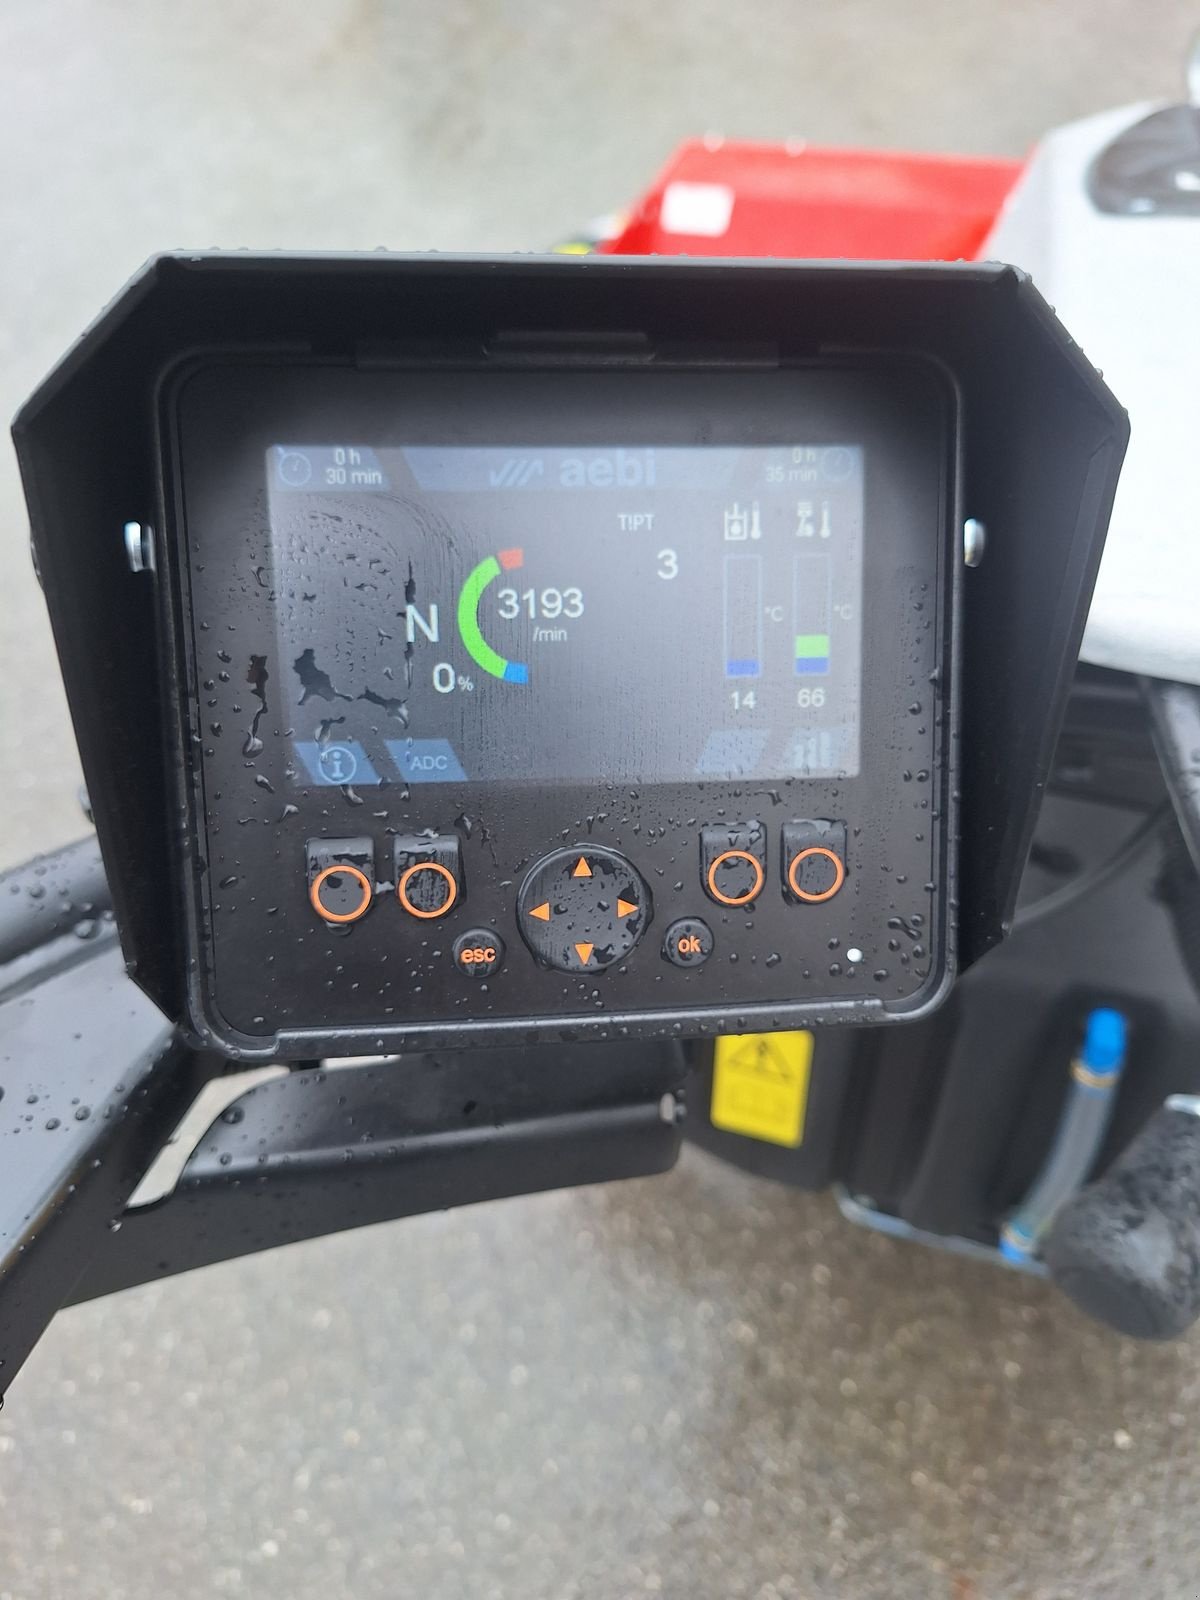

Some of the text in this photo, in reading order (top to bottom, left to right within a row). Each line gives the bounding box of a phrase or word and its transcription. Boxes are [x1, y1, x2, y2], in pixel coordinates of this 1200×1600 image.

[335, 449, 361, 465] 0 h
[326, 468, 382, 485] 30 min
[559, 448, 656, 487] aebi
[788, 468, 817, 482] min
[617, 513, 655, 531] TIPT
[656, 548, 679, 580] 3
[497, 587, 585, 619] 3193
[405, 603, 439, 643] N
[532, 626, 567, 643] /min
[730, 691, 757, 710] 14
[797, 688, 825, 708] 66
[410, 755, 448, 771] ADC
[677, 935, 701, 953] ok
[460, 947, 497, 964] esc
